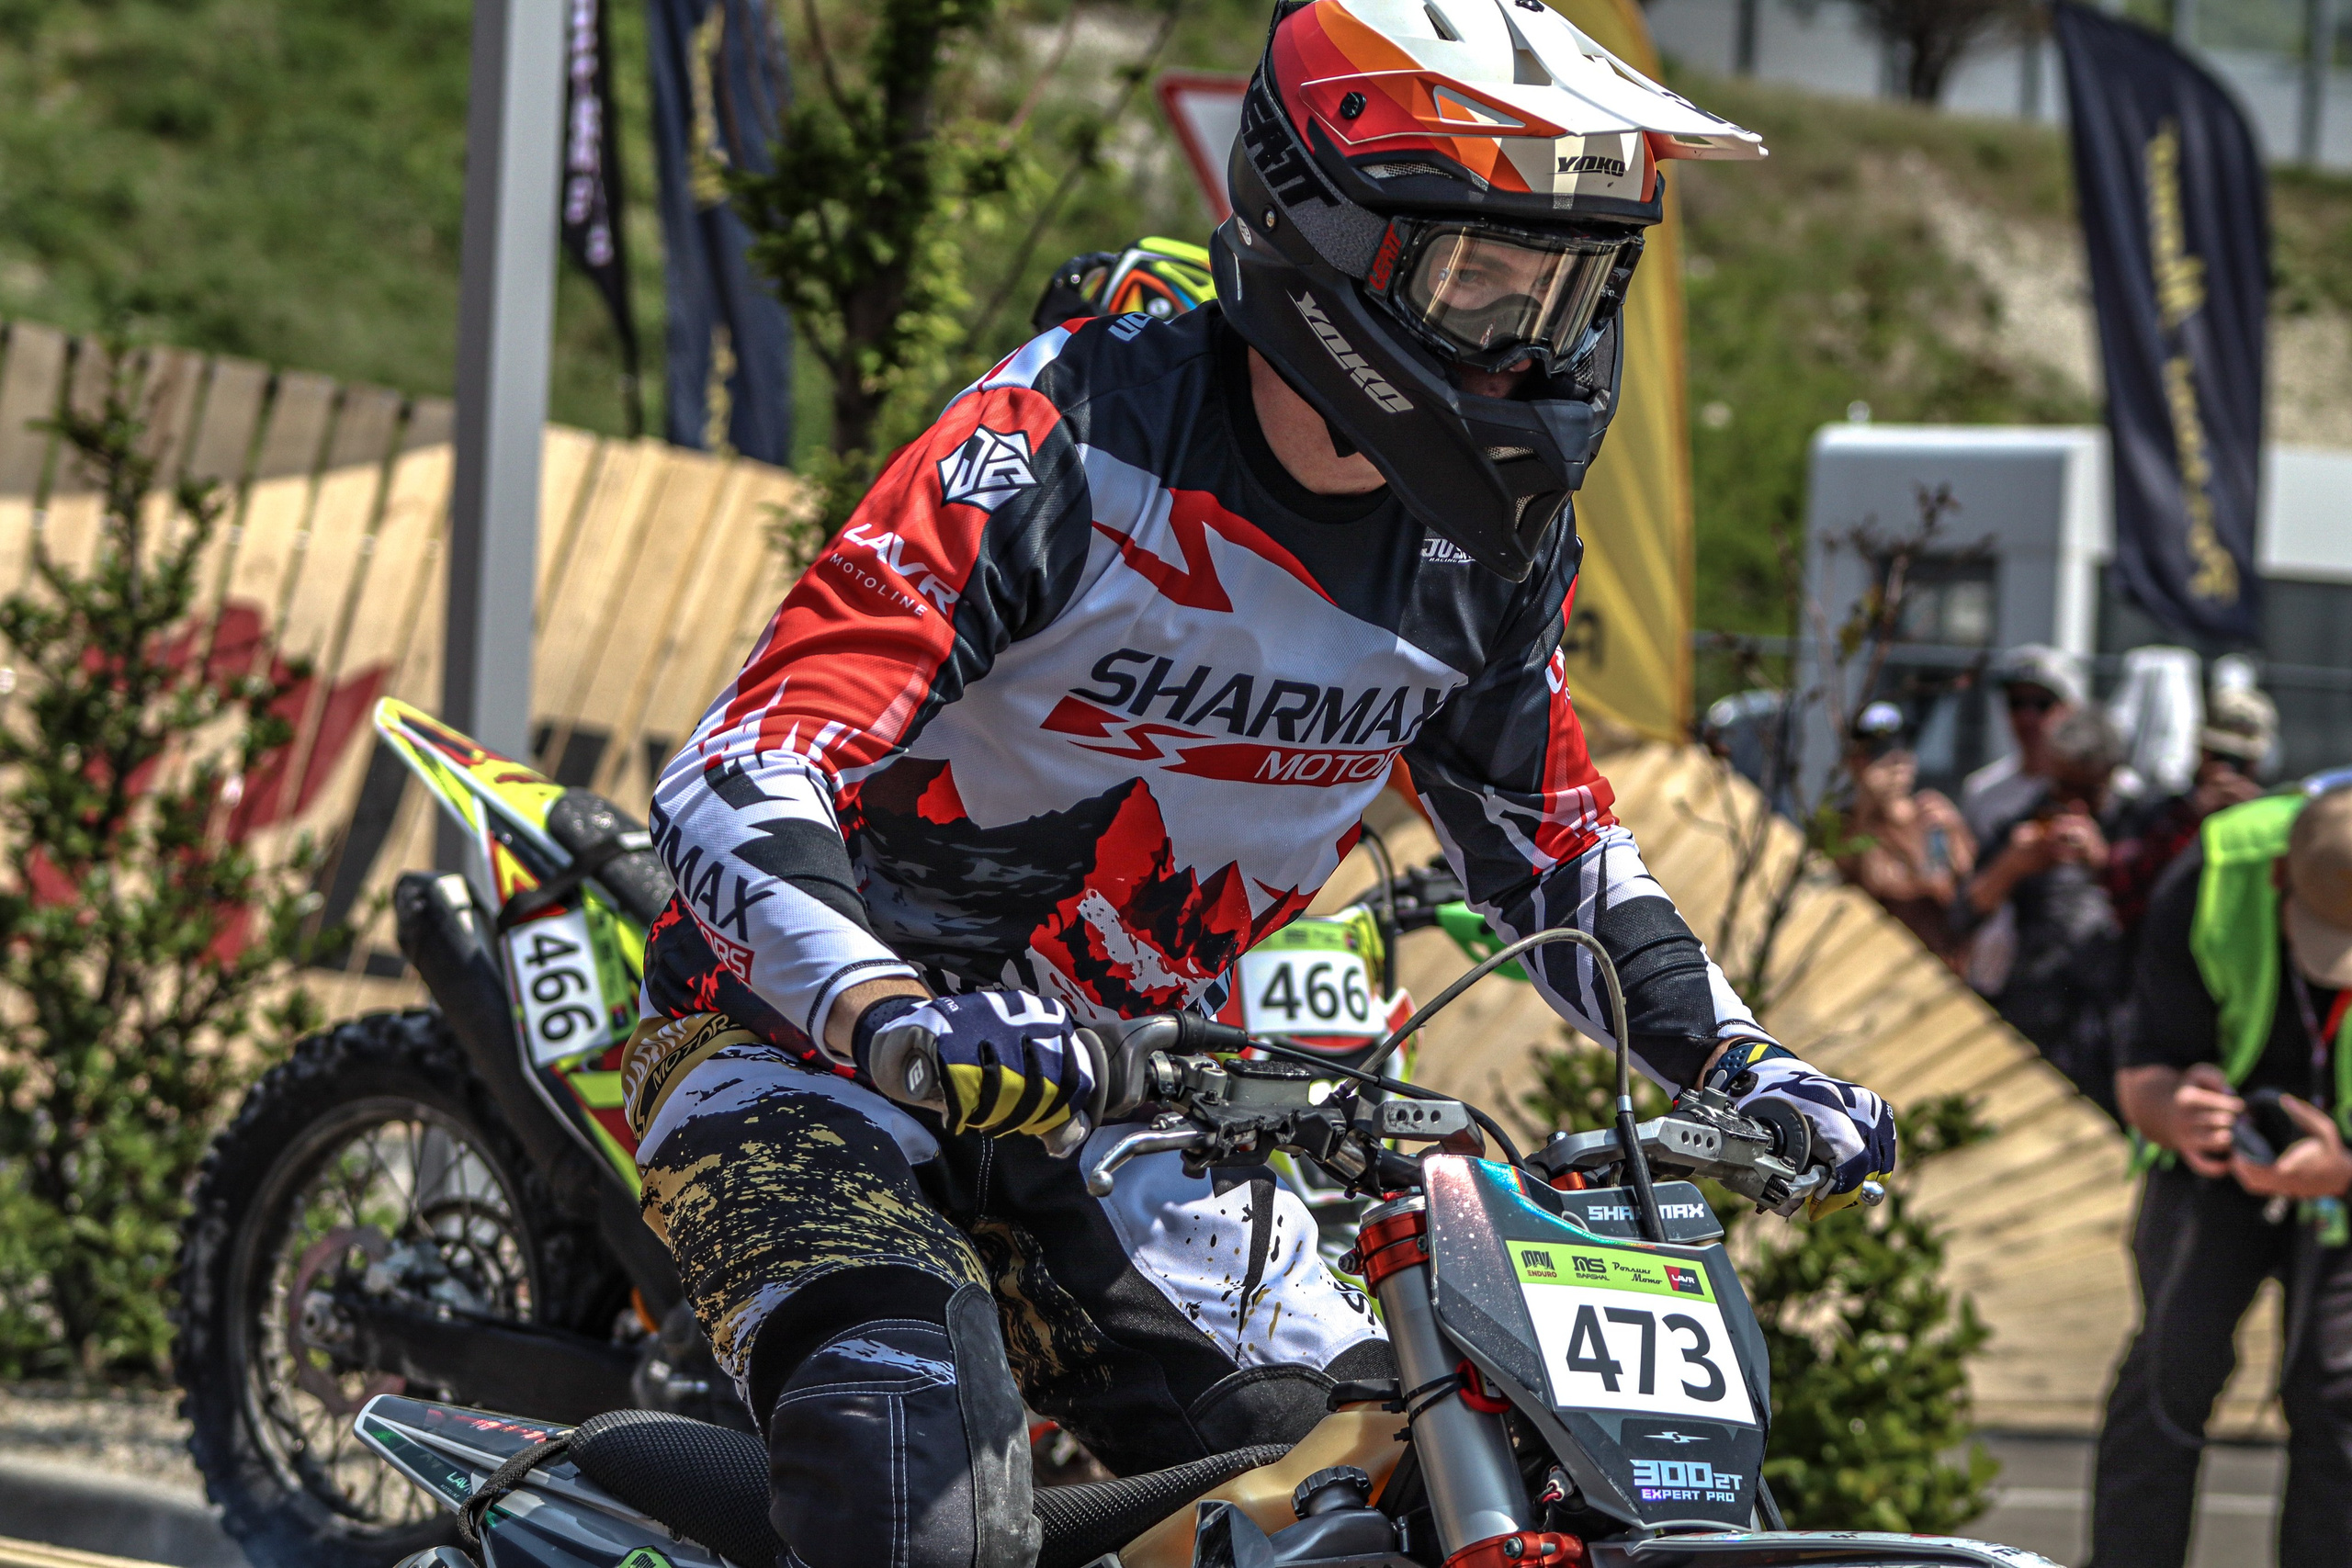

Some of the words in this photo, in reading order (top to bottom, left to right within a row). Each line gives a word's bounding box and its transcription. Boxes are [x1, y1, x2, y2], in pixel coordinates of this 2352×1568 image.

[1555, 154, 1626, 177] YOKO
[1368, 222, 1403, 291] LEATT
[1288, 290, 1414, 413] YOKO
[830, 552, 928, 616] MOTOLINE
[843, 523, 961, 615] LAVR
[524, 931, 598, 1043] 466
[1260, 961, 1370, 1022] 466
[1587, 1202, 1705, 1221] SHAMAX
[1527, 1269, 1557, 1278] ENDURO
[1566, 1304, 1726, 1403] 473
[1641, 1488, 1701, 1501] EXPERT
[1706, 1490, 1735, 1502] PRO
